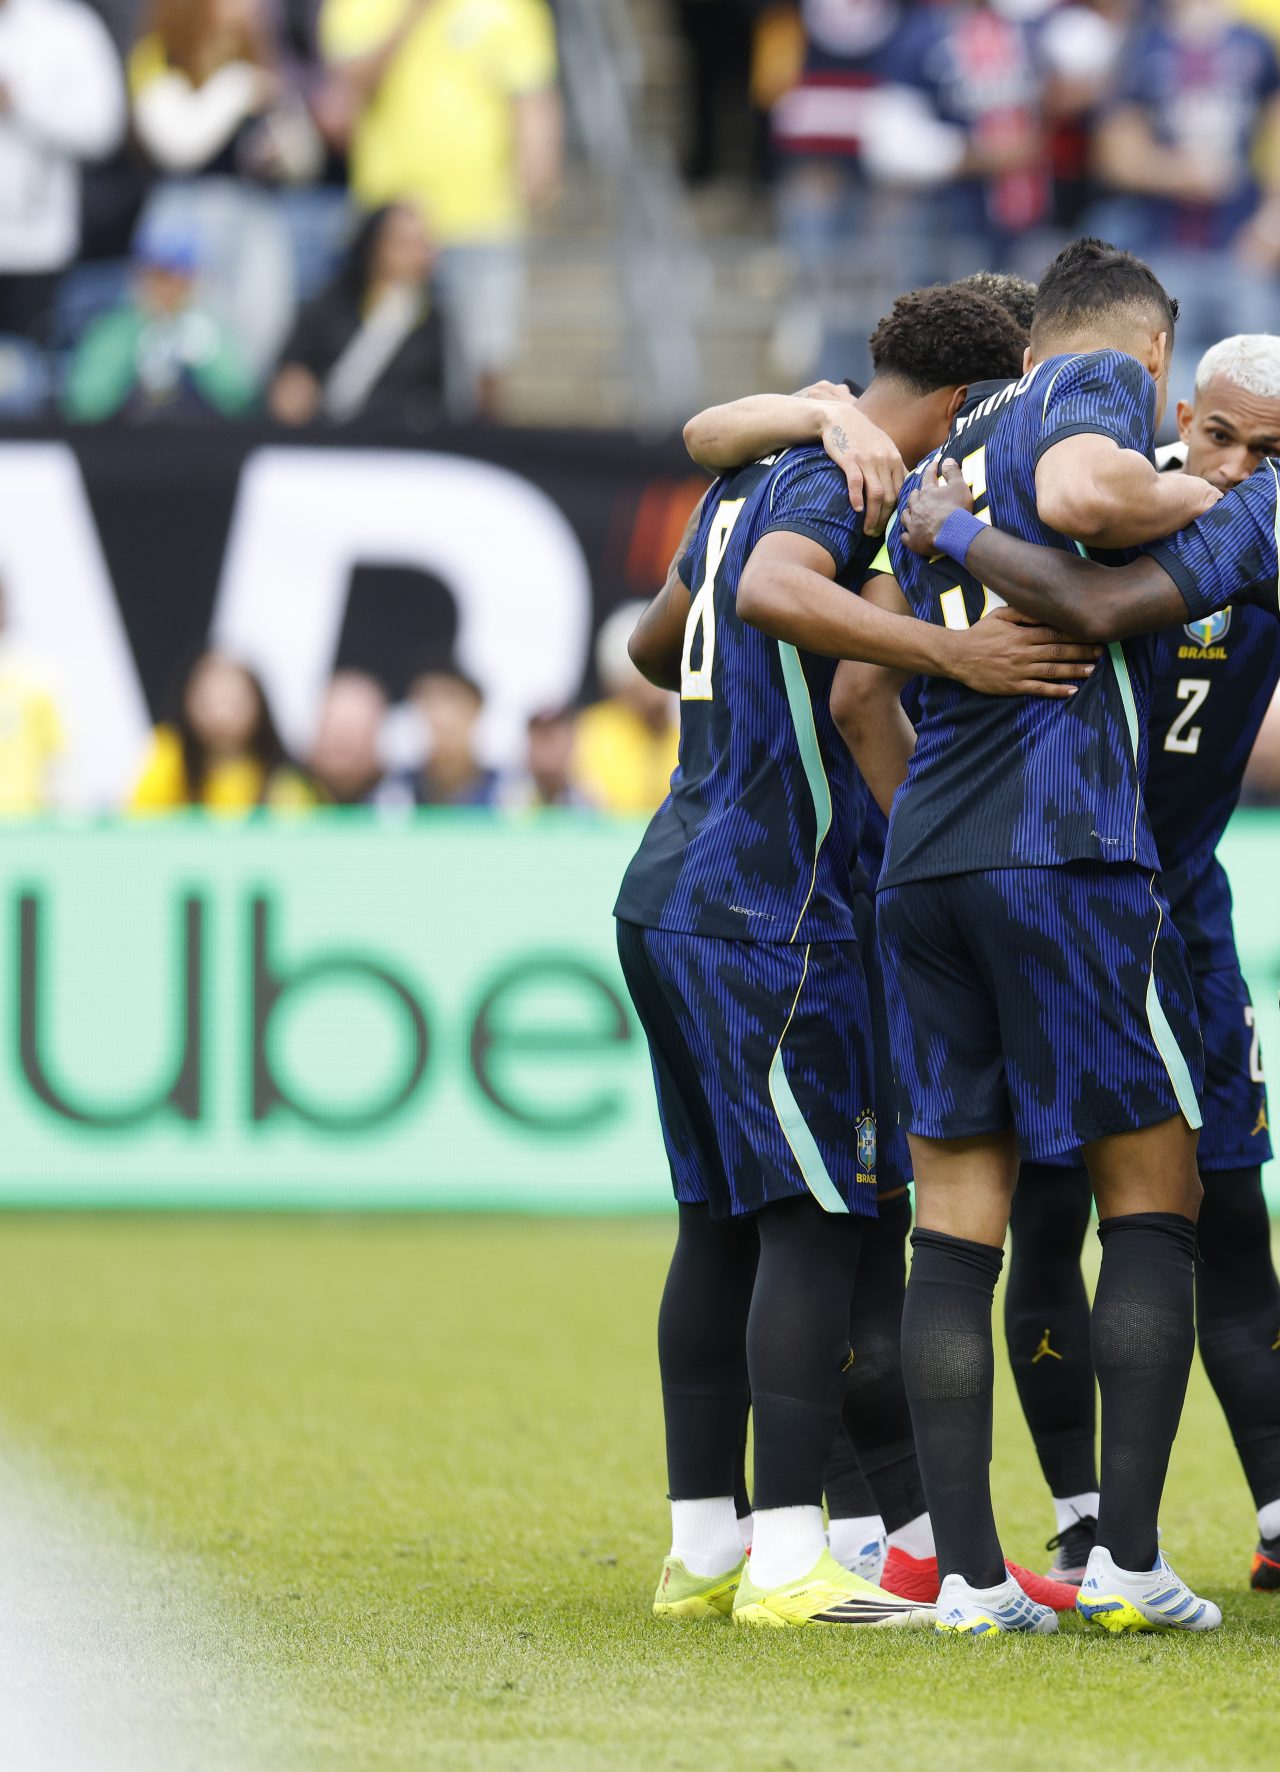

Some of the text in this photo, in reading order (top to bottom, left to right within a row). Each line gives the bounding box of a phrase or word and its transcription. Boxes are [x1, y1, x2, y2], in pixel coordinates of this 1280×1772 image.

[1177, 645, 1228, 660] BRASIL
[1163, 678, 1211, 754] 2
[729, 904, 776, 922] AERO-FIT
[14, 885, 640, 1138] Ube
